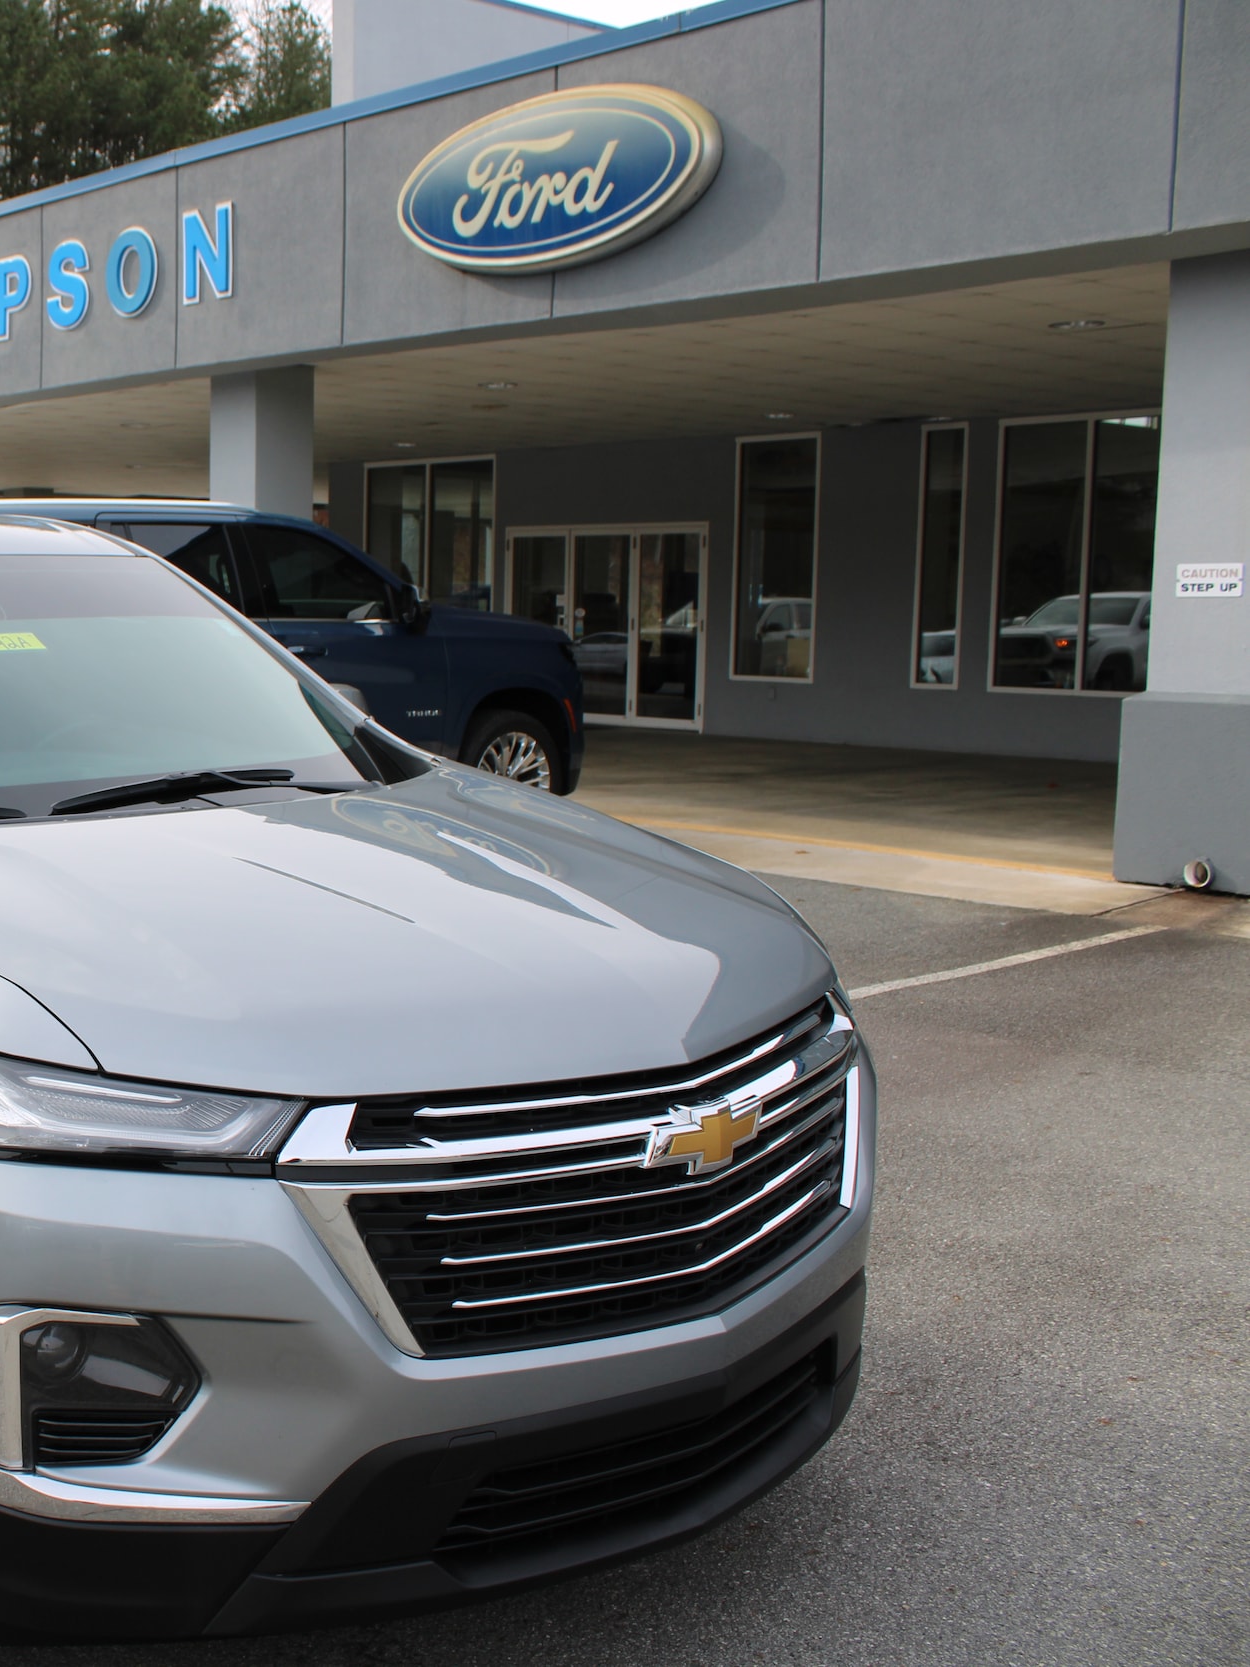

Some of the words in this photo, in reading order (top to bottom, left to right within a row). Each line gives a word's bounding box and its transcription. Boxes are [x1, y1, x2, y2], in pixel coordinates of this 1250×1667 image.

[452, 130, 619, 238] Ford
[1181, 568, 1239, 579] CAUTION
[1181, 582, 1214, 592] STEP
[1220, 582, 1238, 592] UP
